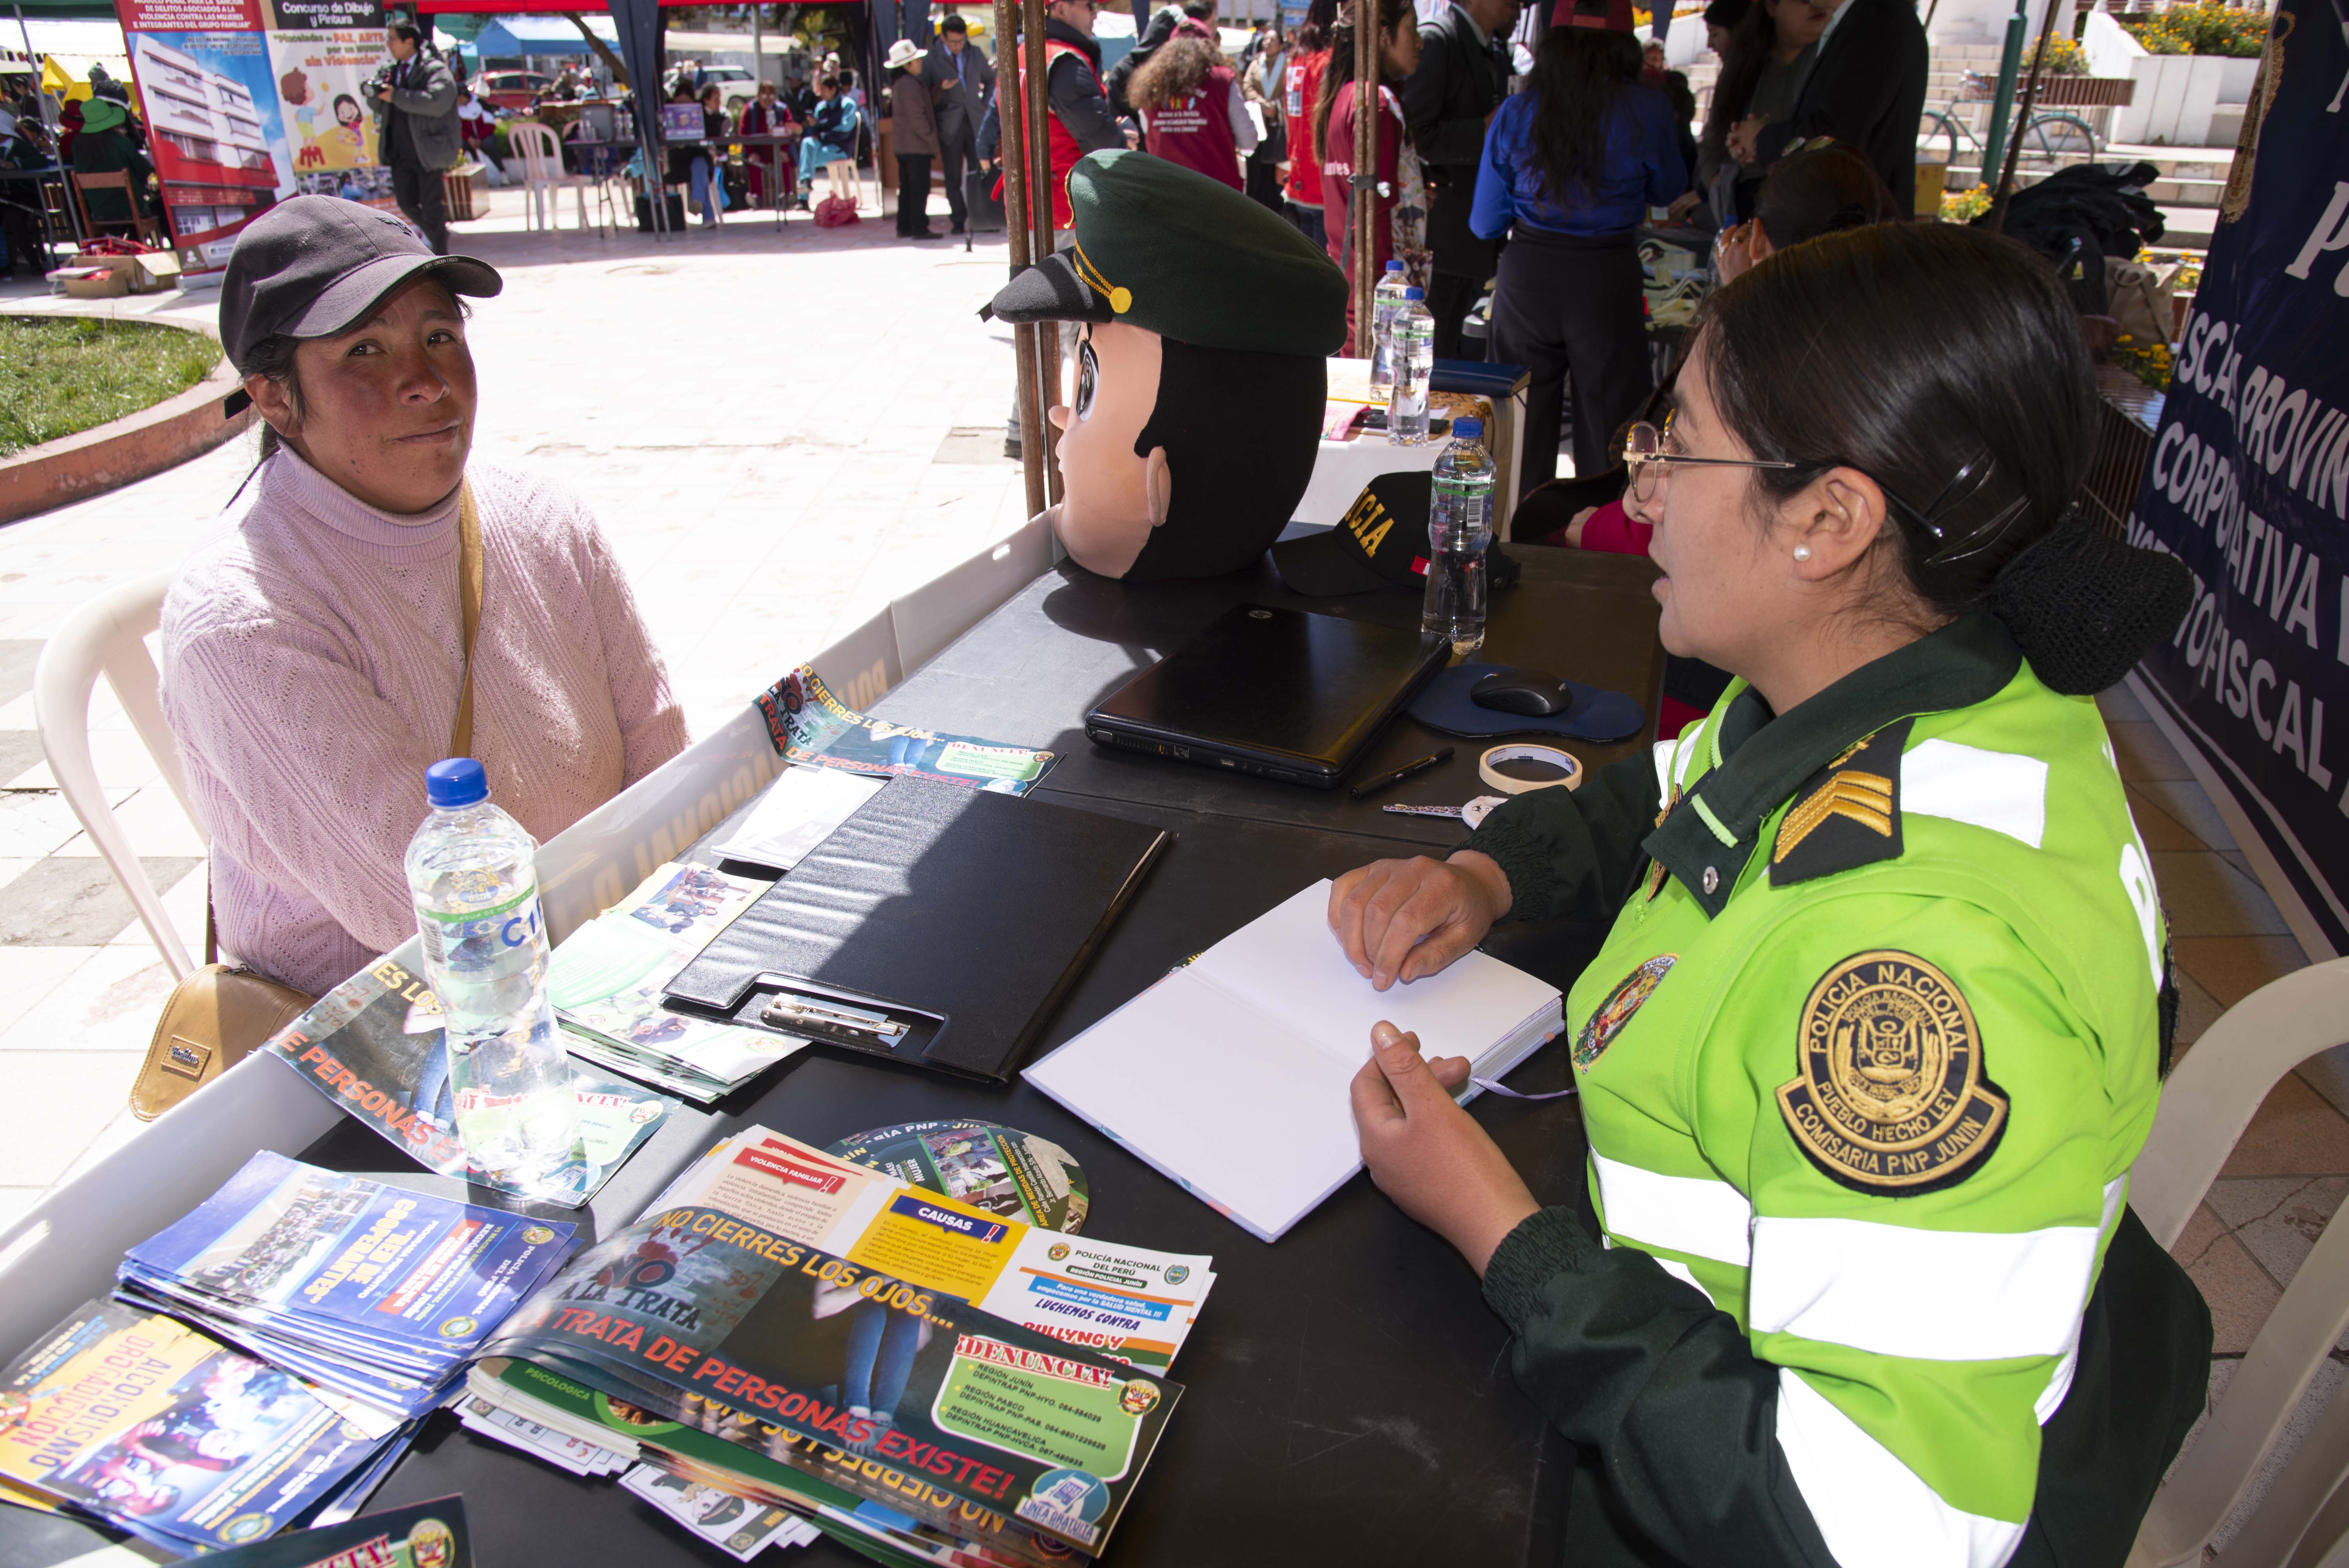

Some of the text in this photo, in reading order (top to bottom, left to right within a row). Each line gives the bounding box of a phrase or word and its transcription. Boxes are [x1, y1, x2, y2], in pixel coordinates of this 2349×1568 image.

[282, 2, 375, 16] Concurso de Dibujo
[310, 14, 353, 27] y Pintura
[810, 678, 864, 725] CIERRES
[862, 719, 895, 732] LOS
[759, 693, 788, 750] TRATA
[785, 746, 815, 761] DE
[812, 754, 910, 775] PERSONAS
[1809, 964, 1970, 1061] POLICIA NACIONAL
[299, 1046, 436, 1146] PERSONAS
[1817, 1080, 1959, 1142] PUEBLO HECHO LEY
[905, 1122, 938, 1133] PNP
[1795, 1103, 1984, 1175] COMISARIA PNP JUNIN
[996, 1134, 1018, 1167] PROTECCIÓN
[750, 1156, 823, 1185] VIOLENCIA FAMILIAR
[906, 1158, 925, 1182] MUJER
[1014, 1166, 1023, 1176] DE
[1033, 1165, 1053, 1198] Bernardo Alcedo
[1018, 1174, 1036, 1201] MEDIDAS
[1034, 1186, 1046, 1202] Ramón
[918, 1207, 973, 1231] CAUSAS
[1030, 1200, 1040, 1211] DE
[1041, 1201, 1051, 1213] Calle
[475, 1232, 497, 1255] MACRO
[651, 1210, 686, 1230] NO
[691, 1212, 805, 1266] CIERRES
[802, 1255, 860, 1289] LOS
[346, 1260, 381, 1287] DE
[356, 1218, 439, 1301] PROGRAMA PREVENTIVO
[402, 1222, 494, 1320] REGIÓN POLICIAL JUNÍN
[1075, 1249, 1162, 1272] POLICÍA NACIONAL
[1093, 1262, 1136, 1276] DEL PERÚ
[471, 1244, 535, 1317] POLICÍA NACIONAL
[476, 1258, 512, 1299] DEL PERÚ
[1069, 1267, 1143, 1287] REGIÓN POLICIAL JUNÍN
[576, 1283, 608, 1302] LA
[616, 1288, 700, 1331] TRATA
[1036, 1285, 1079, 1301] empecemos
[1078, 1295, 1091, 1304] por
[1100, 1299, 1124, 1311] SALUD
[1124, 1304, 1152, 1317] MENTAL
[1056, 1283, 1075, 1292] Para
[1088, 1290, 1124, 1304] verdadera
[1125, 1298, 1146, 1309] salud,
[1034, 1298, 1141, 1331] LUCHEMOS CONTRA
[1109, 1336, 1124, 1349] Y
[525, 1367, 591, 1401] PSICOLOGICA
[972, 1370, 1019, 1393] DEPINTRAP
[977, 1363, 1034, 1389] REGIÓN JUNÍN
[29, 1357, 172, 1467] ALCOHOLISMO
[551, 1308, 643, 1352] TRATA
[643, 1338, 699, 1375] DE
[692, 1357, 876, 1442] PERSONAS
[875, 1427, 1016, 1500] EXISTE!
[959, 1391, 1005, 1413] DEPINTRAP
[964, 1384, 1025, 1412] REGIÓN PASCO
[945, 1412, 992, 1433] DEPINTRAP
[950, 1405, 1047, 1445] REGIÓN HUANCAVELICA
